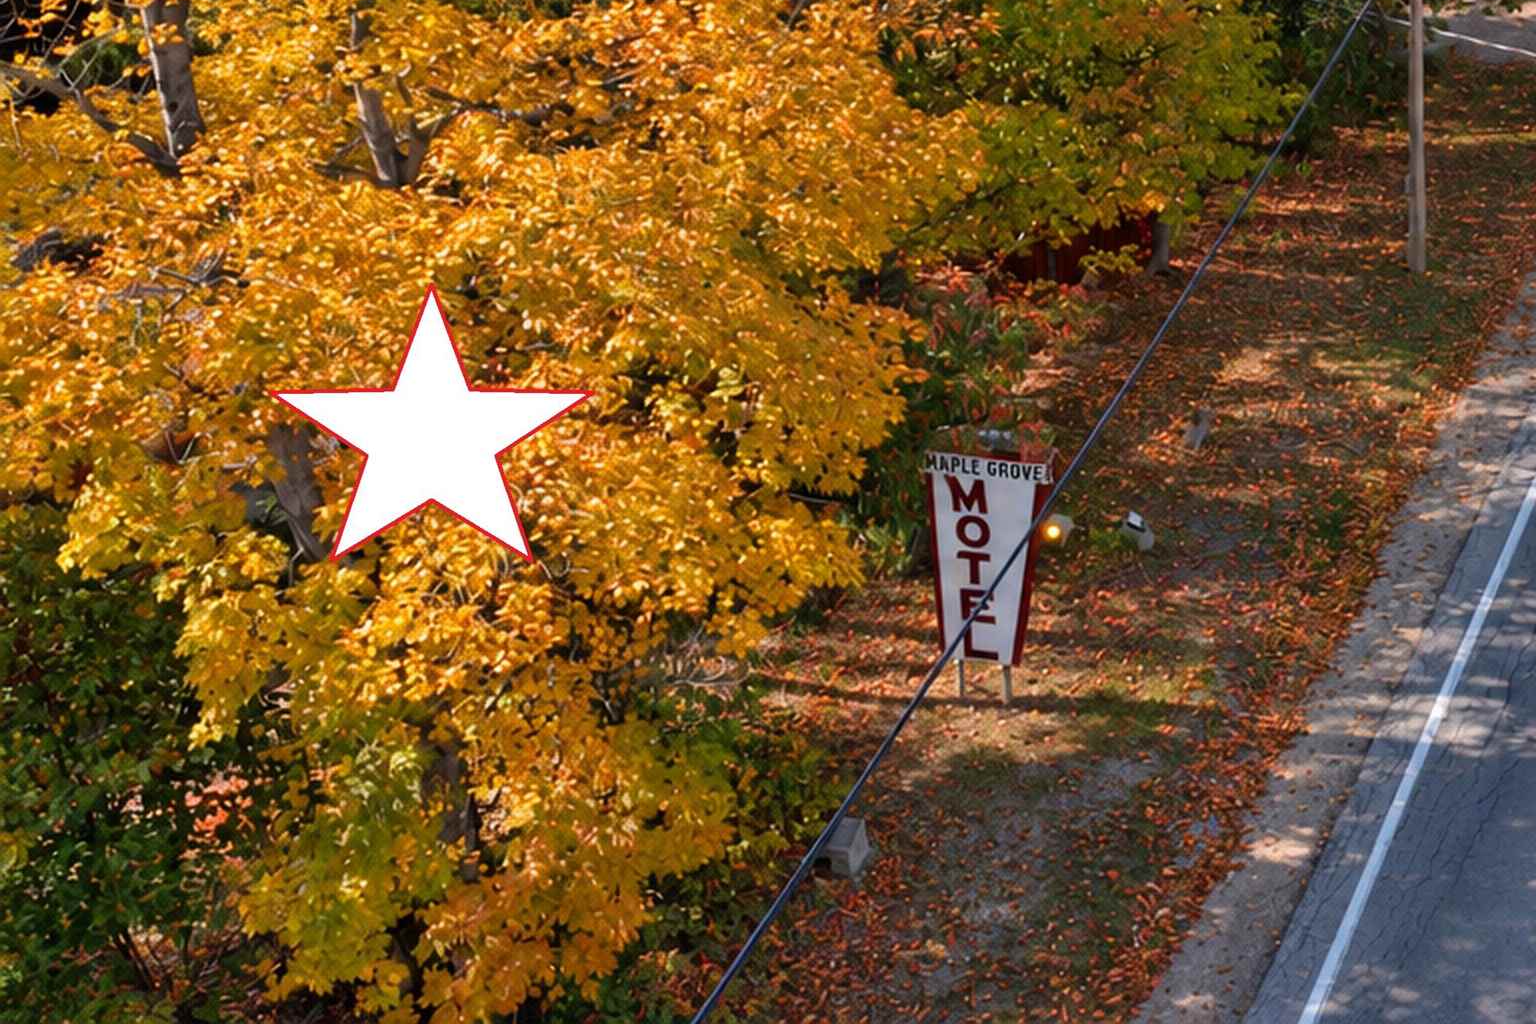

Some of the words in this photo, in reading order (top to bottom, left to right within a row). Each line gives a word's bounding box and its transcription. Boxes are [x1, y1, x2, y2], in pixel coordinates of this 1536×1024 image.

[925, 454, 980, 476] MAPLE
[987, 461, 1043, 481] GROVE
[945, 474, 999, 661] MOTEL
